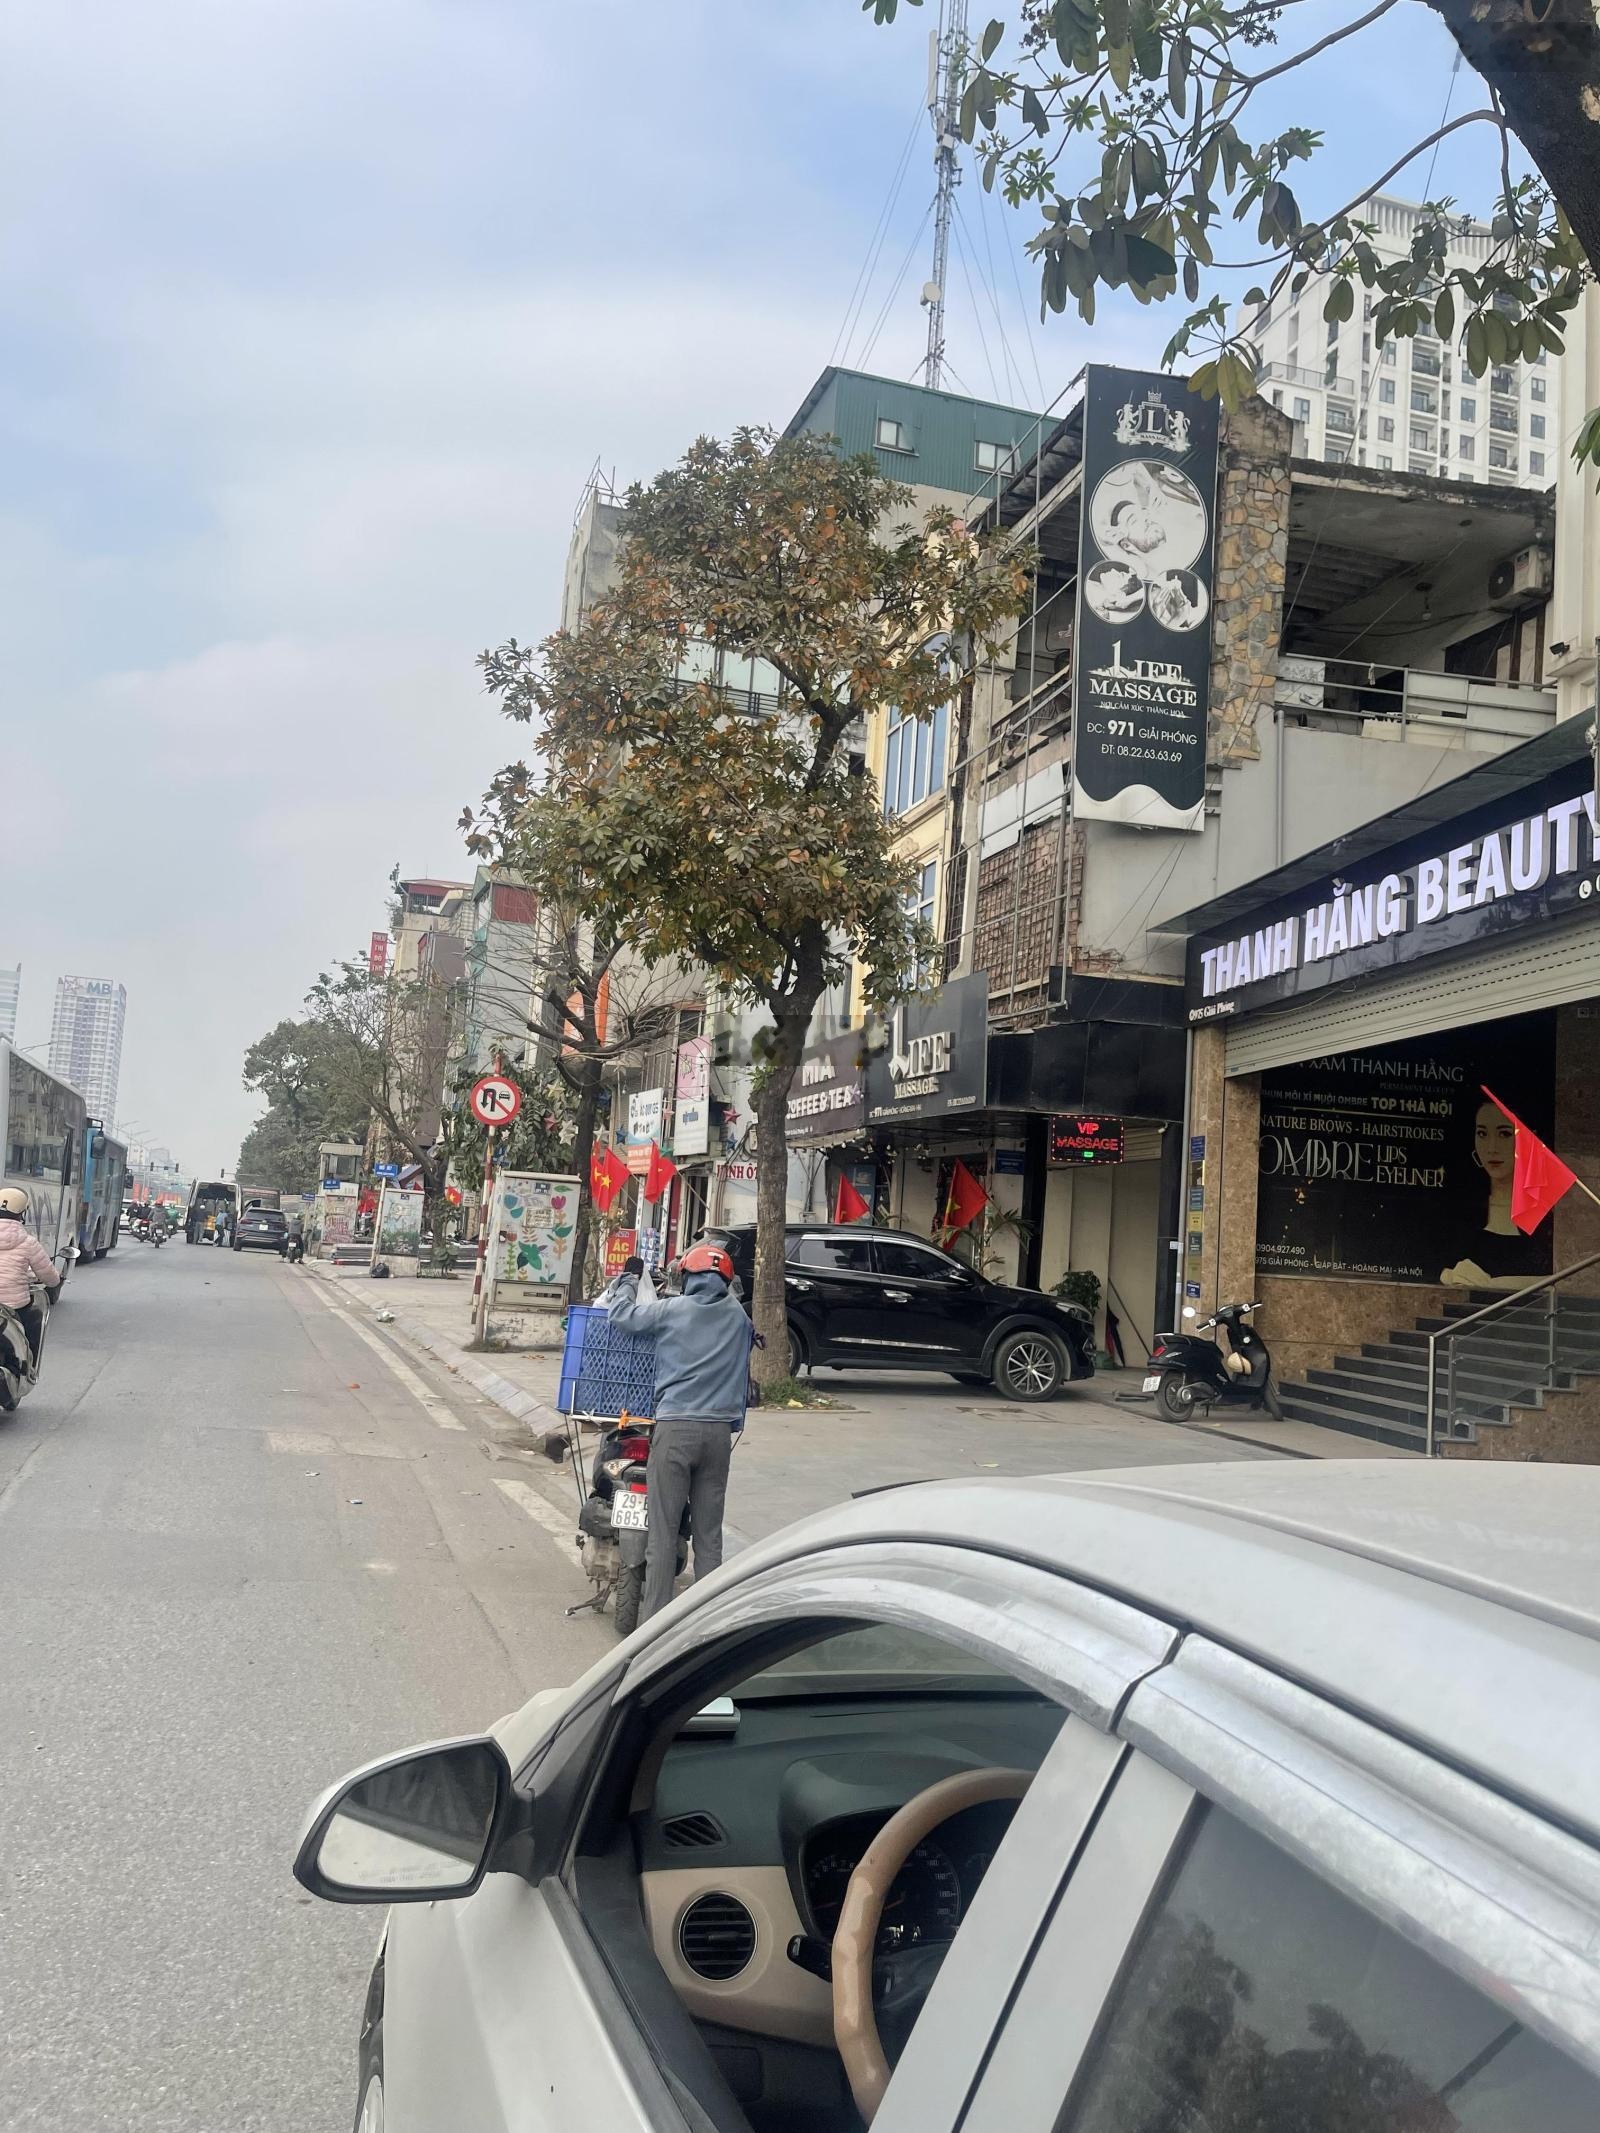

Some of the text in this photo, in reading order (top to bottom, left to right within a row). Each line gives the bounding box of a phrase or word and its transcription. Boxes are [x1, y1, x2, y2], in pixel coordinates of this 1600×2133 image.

[1089, 678, 1197, 706] MASSAGE
[1087, 719, 1198, 745] ĐC: 971 GIẢI PHÓNG
[1101, 743, 1183, 763] ĐT: 08.22.63.63.69
[1200, 916, 1299, 998] THANH
[1303, 874, 1405, 964] HẰNG
[86, 981, 111, 995] MB
[1351, 1057, 1410, 1078] THANH
[1415, 1058, 1464, 1082] HẰNG
[894, 1077, 938, 1100] MASSAGE
[1371, 1096, 1396, 1110] TOP
[1407, 1098, 1426, 1113] HÀ
[1429, 1100, 1453, 1118] NỘI
[1077, 1121, 1099, 1135] VIP
[1310, 1117, 1353, 1134] BROWS
[1362, 1122, 1445, 1141] HAIRSTROKES
[1056, 1136, 1119, 1151] MASSAGE
[1377, 1144, 1407, 1165] LIPS
[1260, 1134, 1374, 1182] OMBRE
[717, 1164, 744, 1179] INH
